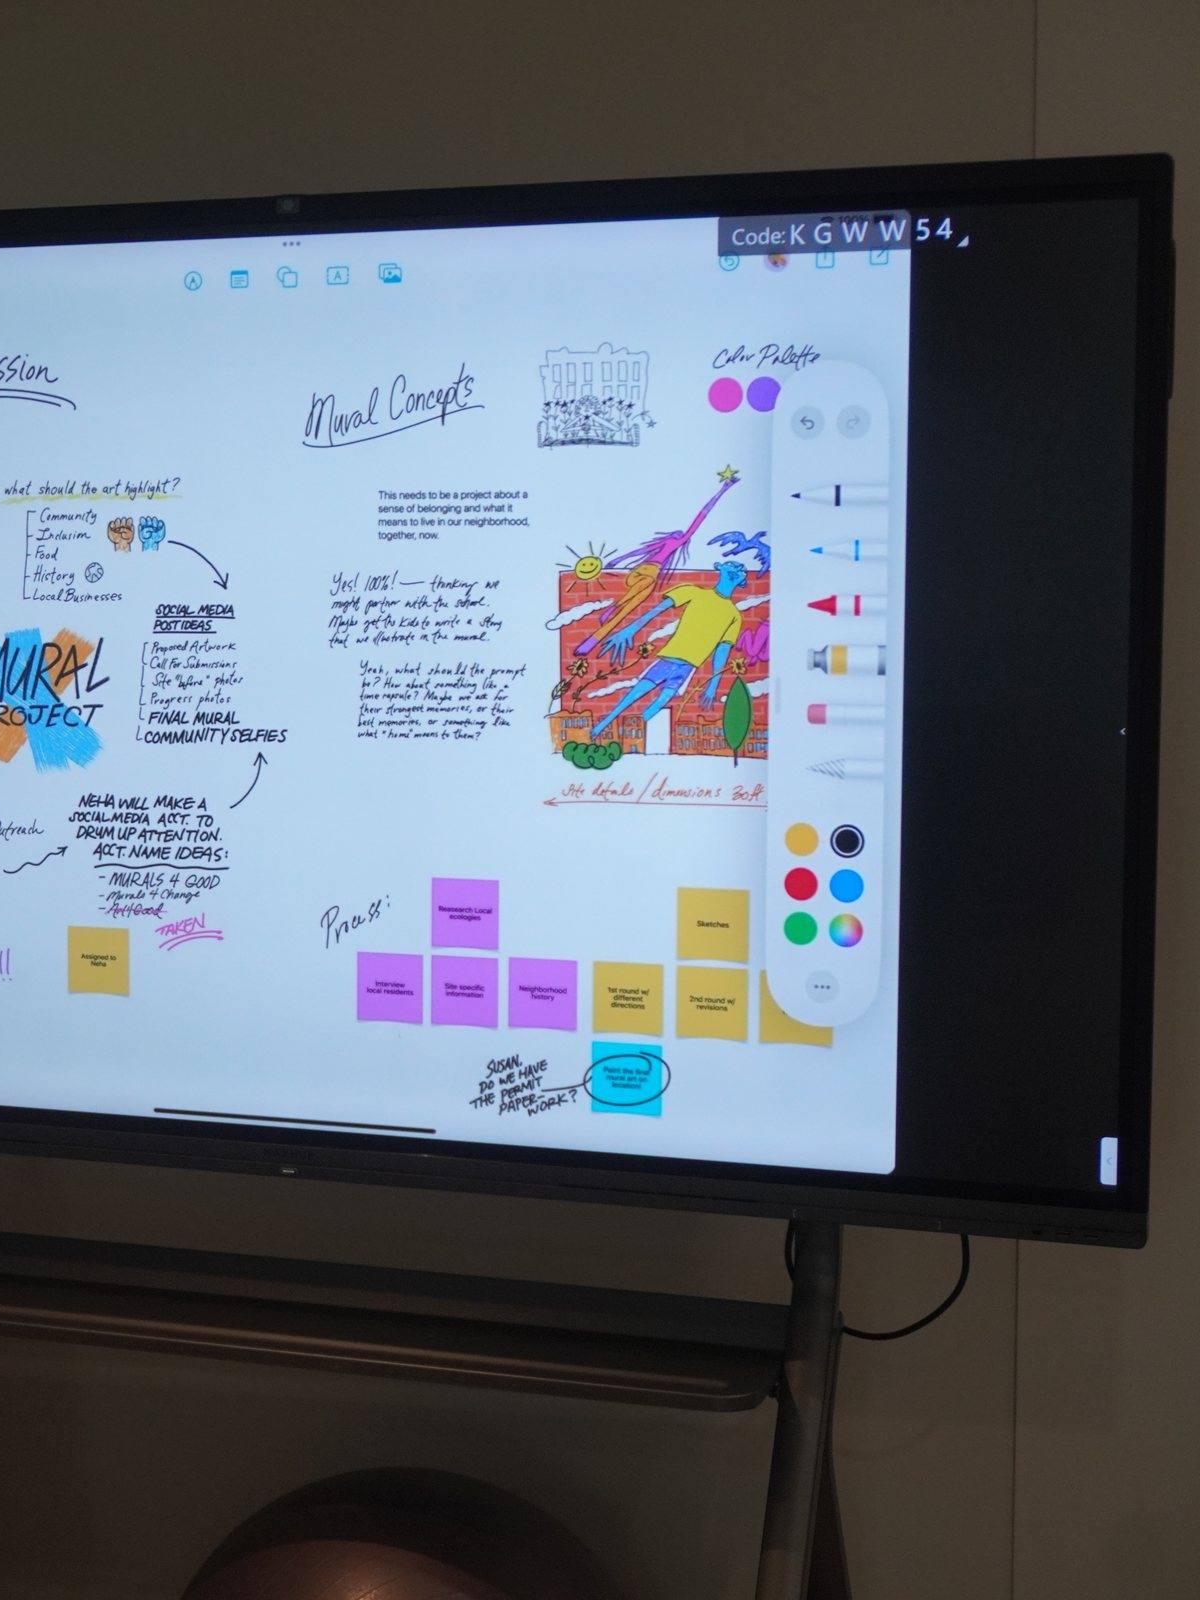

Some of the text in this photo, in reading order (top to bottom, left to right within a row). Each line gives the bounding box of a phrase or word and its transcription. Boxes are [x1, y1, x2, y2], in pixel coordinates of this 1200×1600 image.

[712, 344, 821, 371] Color Palette
[305, 363, 474, 446] Mural Concepts
[4, 477, 181, 501] what should the art highlight?
[379, 491, 397, 499] This
[399, 491, 426, 500] needs
[429, 491, 437, 499] to
[439, 490, 451, 499] be
[461, 490, 491, 501] project
[494, 490, 520, 499] about
[40, 507, 97, 524] Community
[406, 504, 415, 513] of
[418, 504, 462, 514] belonging
[464, 504, 481, 512] and
[483, 503, 504, 512] what
[507, 503, 513, 512] it
[410, 518, 418, 526] to
[421, 517, 435, 526] live
[438, 517, 445, 526] in
[448, 518, 462, 526] our
[464, 517, 530, 527] neighborhood,
[36, 527, 91, 541] Inclusion
[378, 531, 439, 541] together, now.
[35, 545, 58, 561] Food
[33, 565, 75, 585] History
[330, 572, 359, 596] Yes!
[364, 570, 398, 591] 100%!
[485, 581, 500, 590] we
[33, 588, 122, 603] Local Businesses
[155, 604, 234, 616] SOCIAL MEDIA
[360, 660, 526, 680] Yeah, what should the prompt
[151, 688, 231, 710] Progress photos
[149, 711, 240, 726] FINAL MURAL
[144, 727, 288, 745] COMMUNITY SELFIES
[79, 793, 207, 811] NEHA WILL MAKE A
[157, 812, 189, 825] ACCT.
[196, 814, 213, 827] TO
[76, 826, 223, 843] DRUM UP ATTENTION.
[93, 843, 228, 861] ACCT. NAME IDEAS:
[109, 872, 220, 890] MURALS 4 GOOD
[155, 913, 206, 936] TAKEN
[320, 894, 391, 949] Process:
[696, 920, 730, 929] Sketches
[90, 960, 107, 968] Neha
[366, 987, 414, 997] local residents
[375, 980, 406, 989] Interview
[519, 984, 567, 994] Neighborhood
[531, 993, 555, 1001] history
[689, 996, 703, 1005] 2nd
[696, 1004, 728, 1012] revisions
[479, 1059, 548, 1094] DO WE HAVE
[470, 1076, 543, 1110] THE PERMIT
[527, 1089, 578, 1117] WORK?
